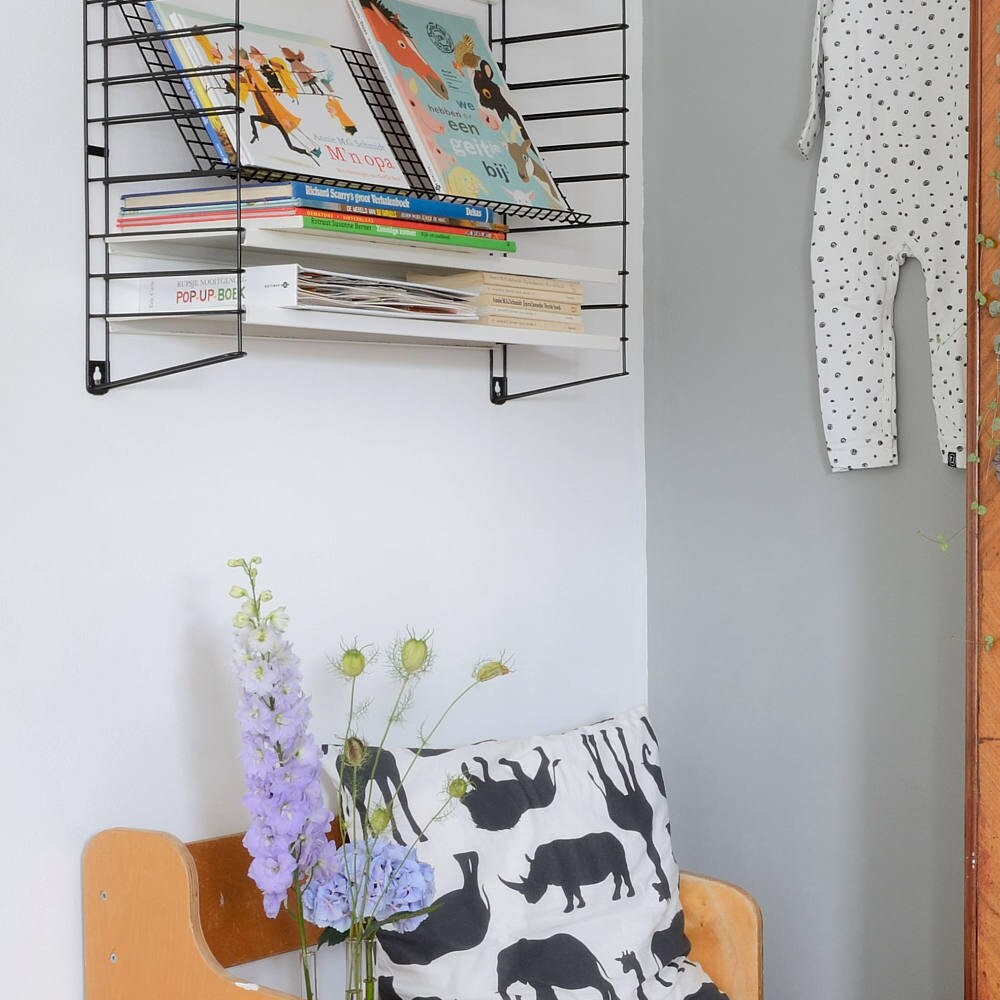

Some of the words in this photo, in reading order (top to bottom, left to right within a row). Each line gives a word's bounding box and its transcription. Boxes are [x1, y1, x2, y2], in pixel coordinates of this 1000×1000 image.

[427, 104, 462, 118] hebben
[455, 100, 476, 111] we
[448, 120, 480, 136] een
[364, 154, 396, 173] opa
[305, 185, 330, 198] Richard
[330, 188, 354, 202] Scarry's
[355, 193, 371, 203] groot
[371, 193, 410, 208] Verhalenboek
[465, 207, 482, 217] Deltas
